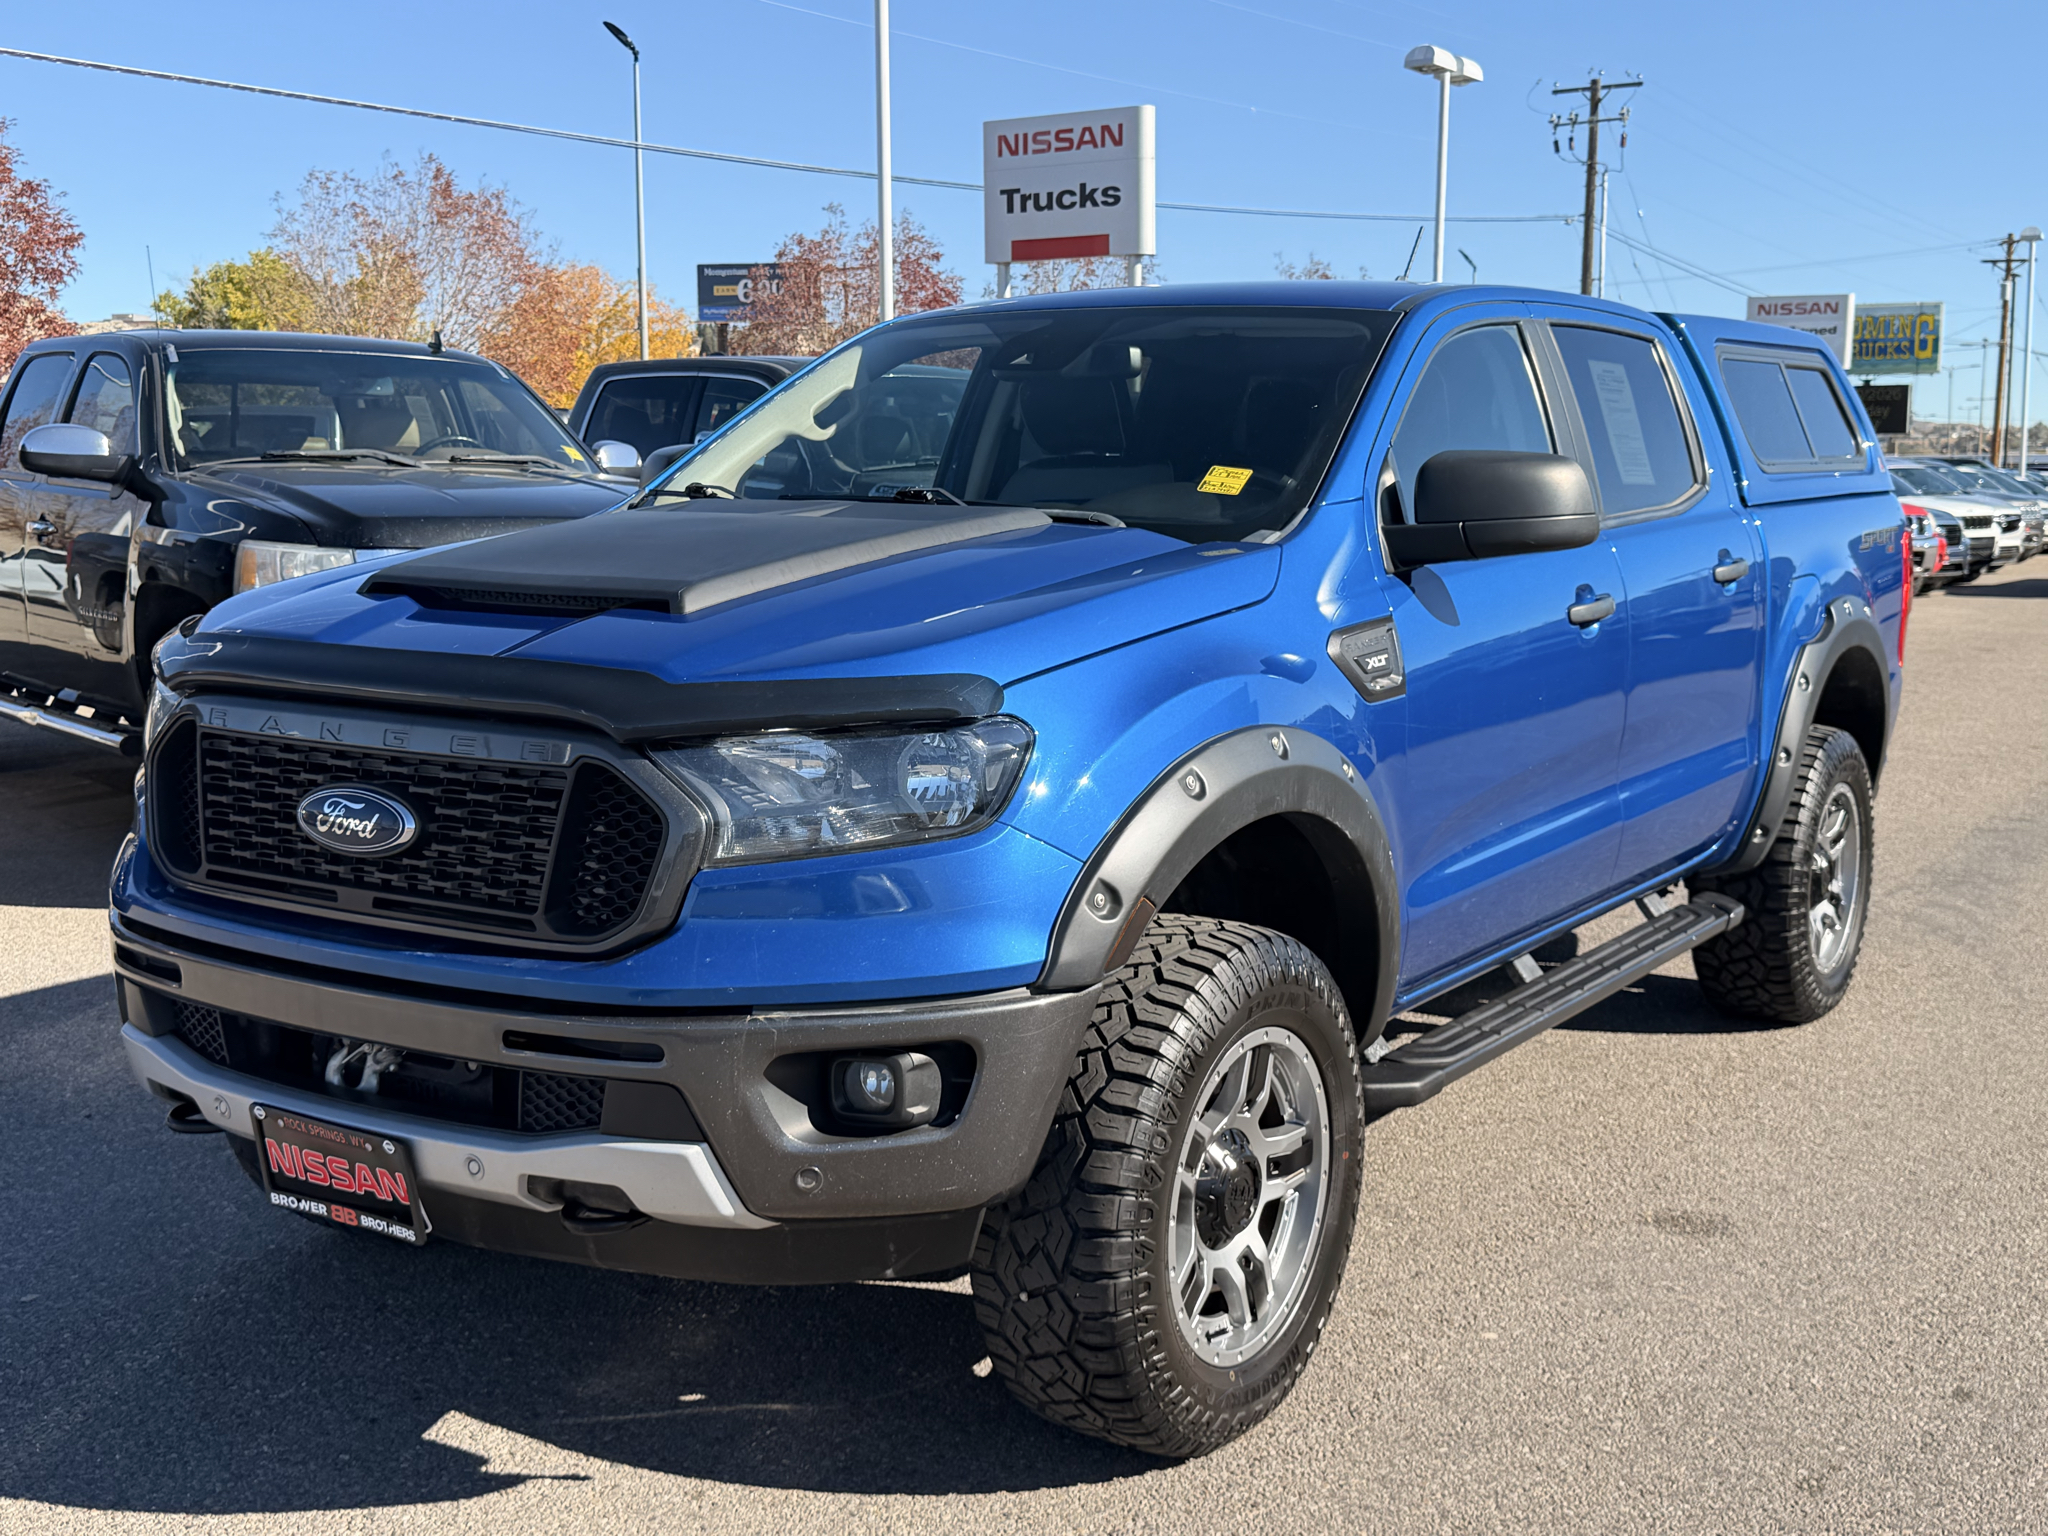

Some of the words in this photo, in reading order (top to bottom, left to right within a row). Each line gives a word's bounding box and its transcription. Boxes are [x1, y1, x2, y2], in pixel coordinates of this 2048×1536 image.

[997, 123, 1124, 158] NISSAN
[999, 182, 1122, 214] Trucks
[1757, 301, 1840, 317] NISSAN
[1365, 653, 1389, 670] XLT
[208, 707, 550, 763] RANGER
[316, 798, 380, 839] Ford
[283, 1116, 308, 1134] ROCK
[265, 1137, 411, 1205] NISSAN
[270, 1191, 328, 1216] BROWER
[360, 1214, 416, 1242] BROTHERS
